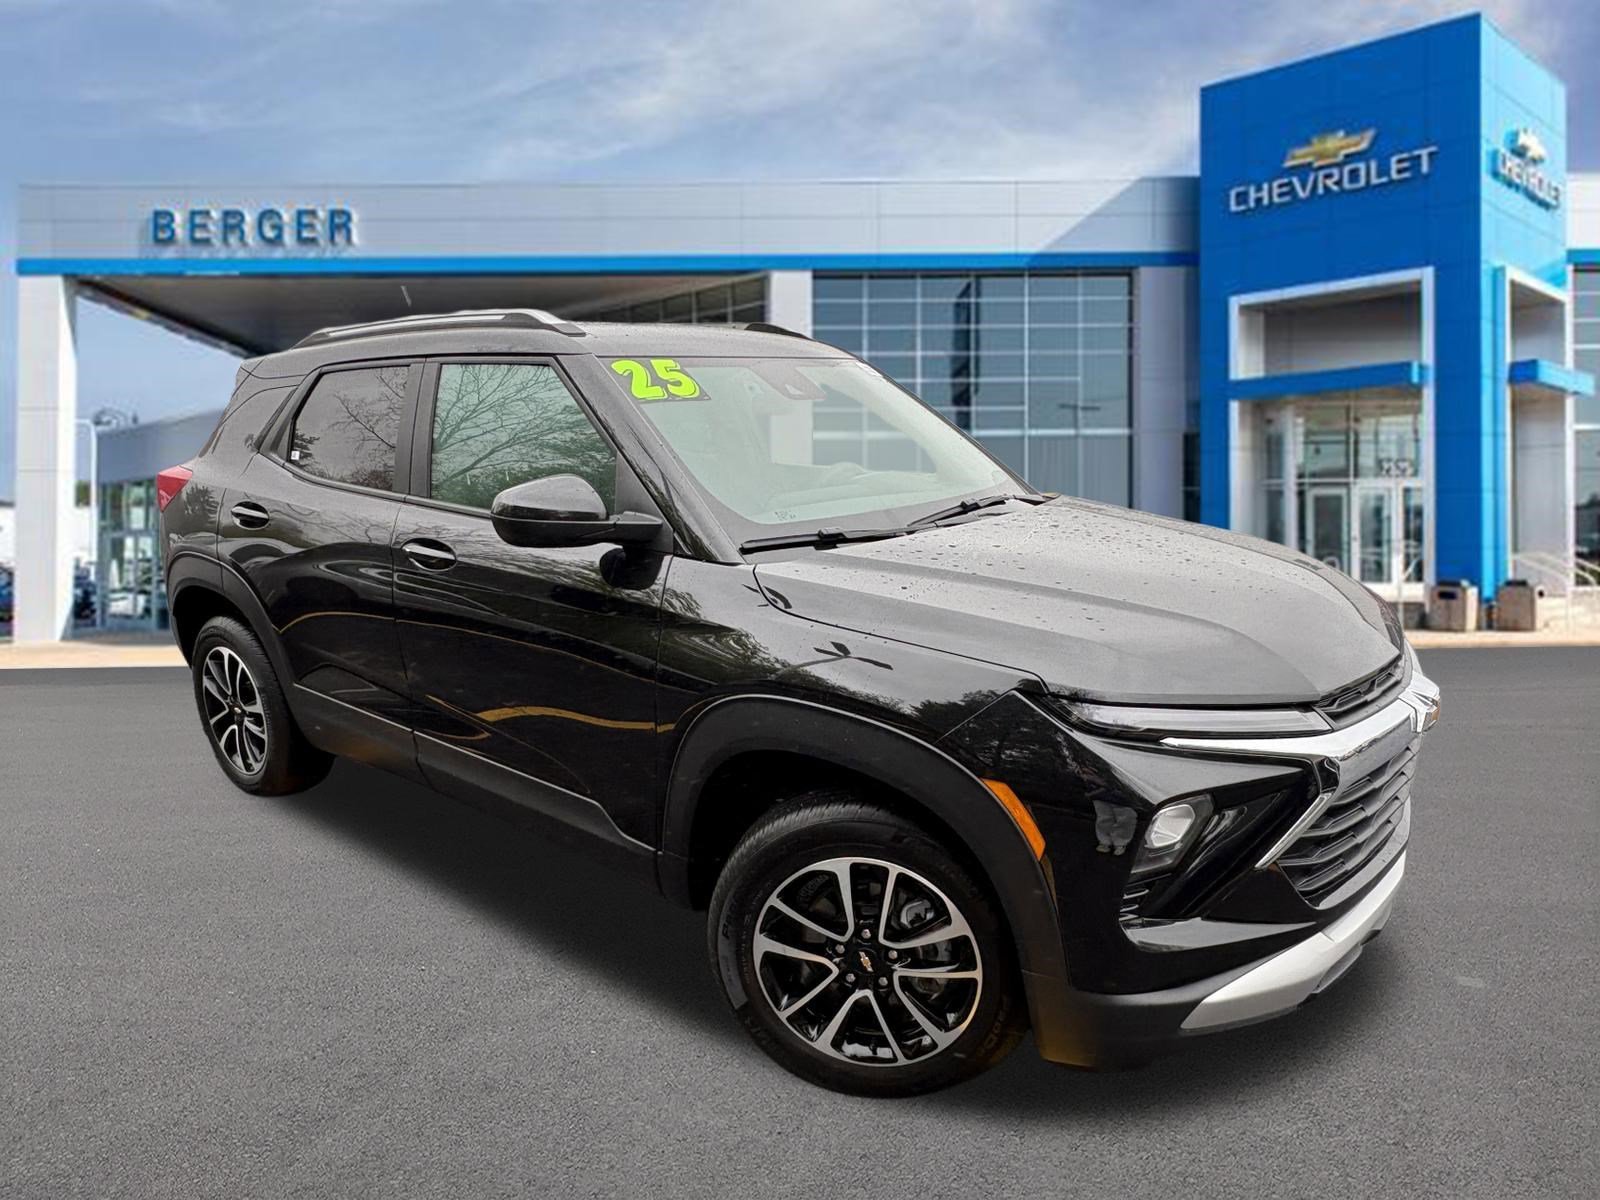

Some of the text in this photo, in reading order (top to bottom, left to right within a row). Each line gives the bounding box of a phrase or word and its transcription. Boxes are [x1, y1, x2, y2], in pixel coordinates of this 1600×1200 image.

[1229, 146, 1438, 212] CHEVROLET
[152, 208, 355, 246] BERGER
[610, 358, 700, 400] 25
